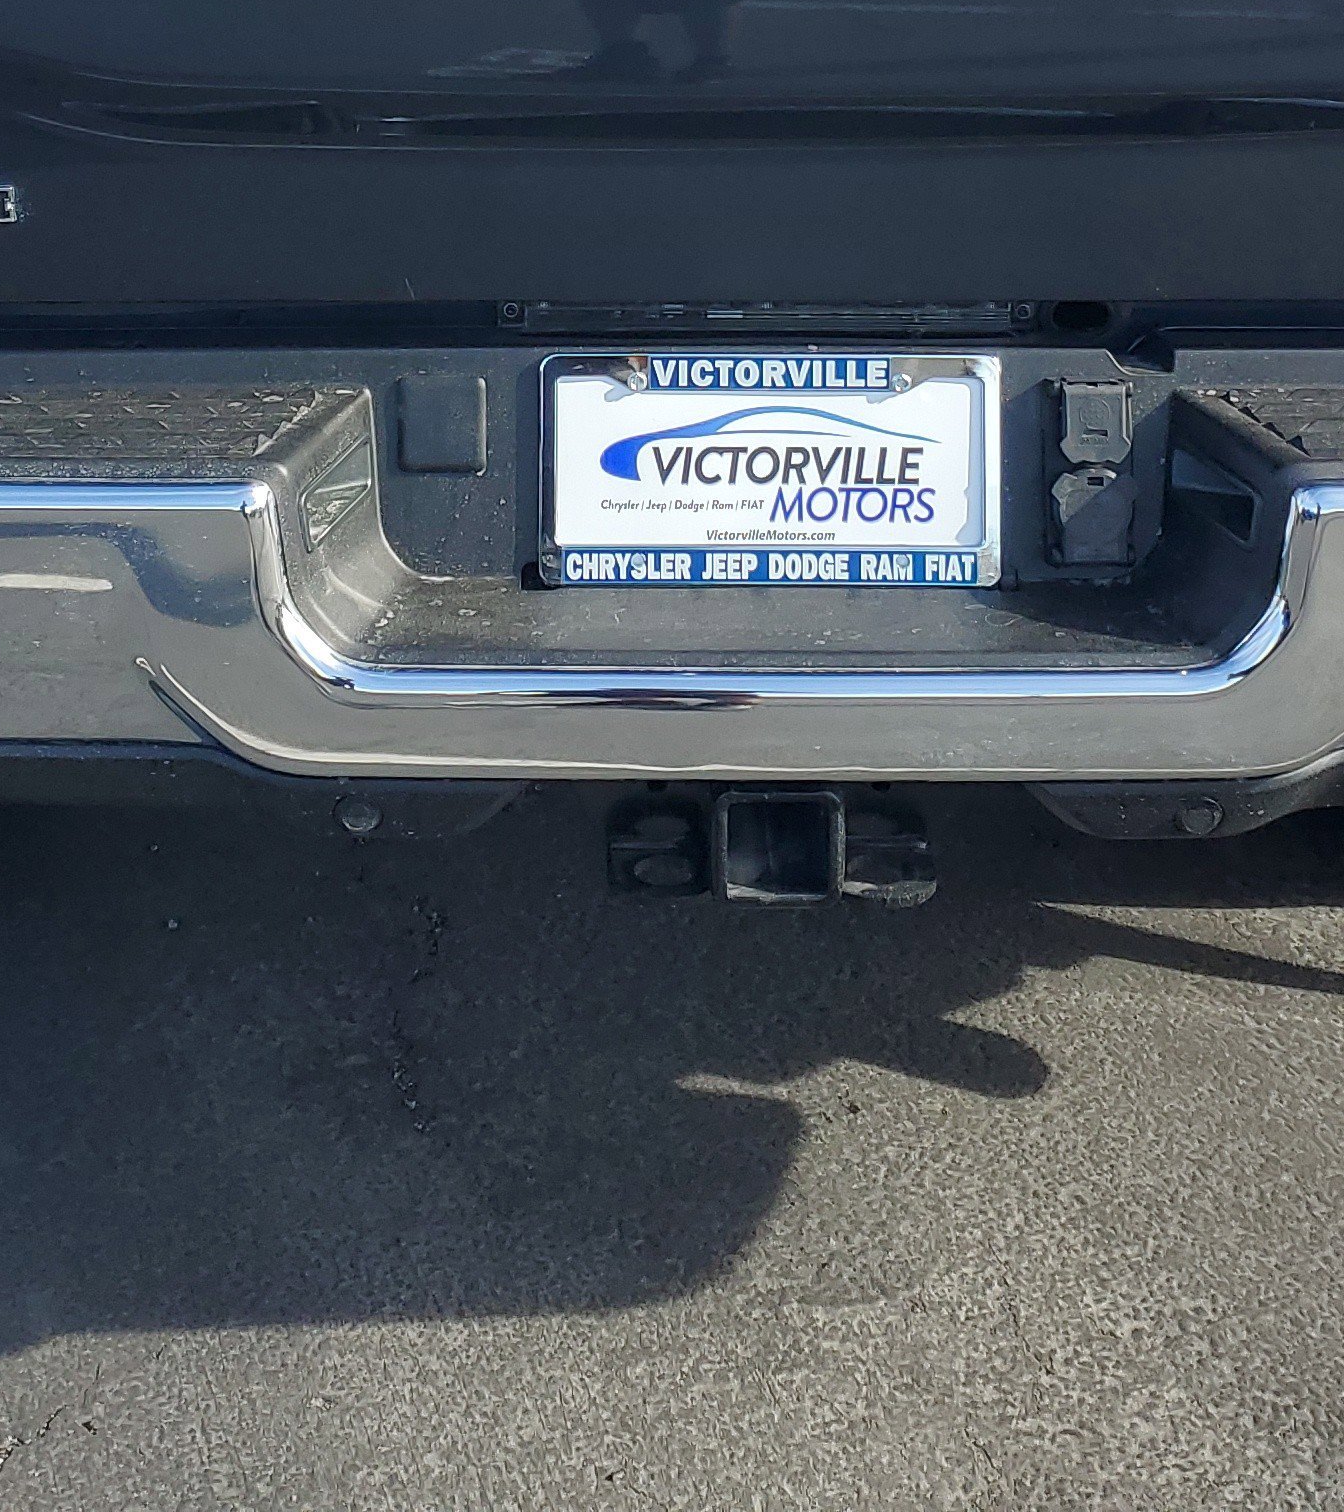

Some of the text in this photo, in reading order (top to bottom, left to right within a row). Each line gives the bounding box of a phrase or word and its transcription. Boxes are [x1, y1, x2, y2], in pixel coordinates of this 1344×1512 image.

[653, 360, 888, 388] VICTORVILLE
[652, 446, 924, 486] VICTORVILLE
[600, 499, 765, 513] Chrysler Jeep Dodge Ram FIAT
[770, 486, 936, 523] MOTORS
[706, 529, 836, 541] VictorvilleMotors.com
[566, 552, 976, 581] CHRYSLER JEEP DODGE RAM FIAT
